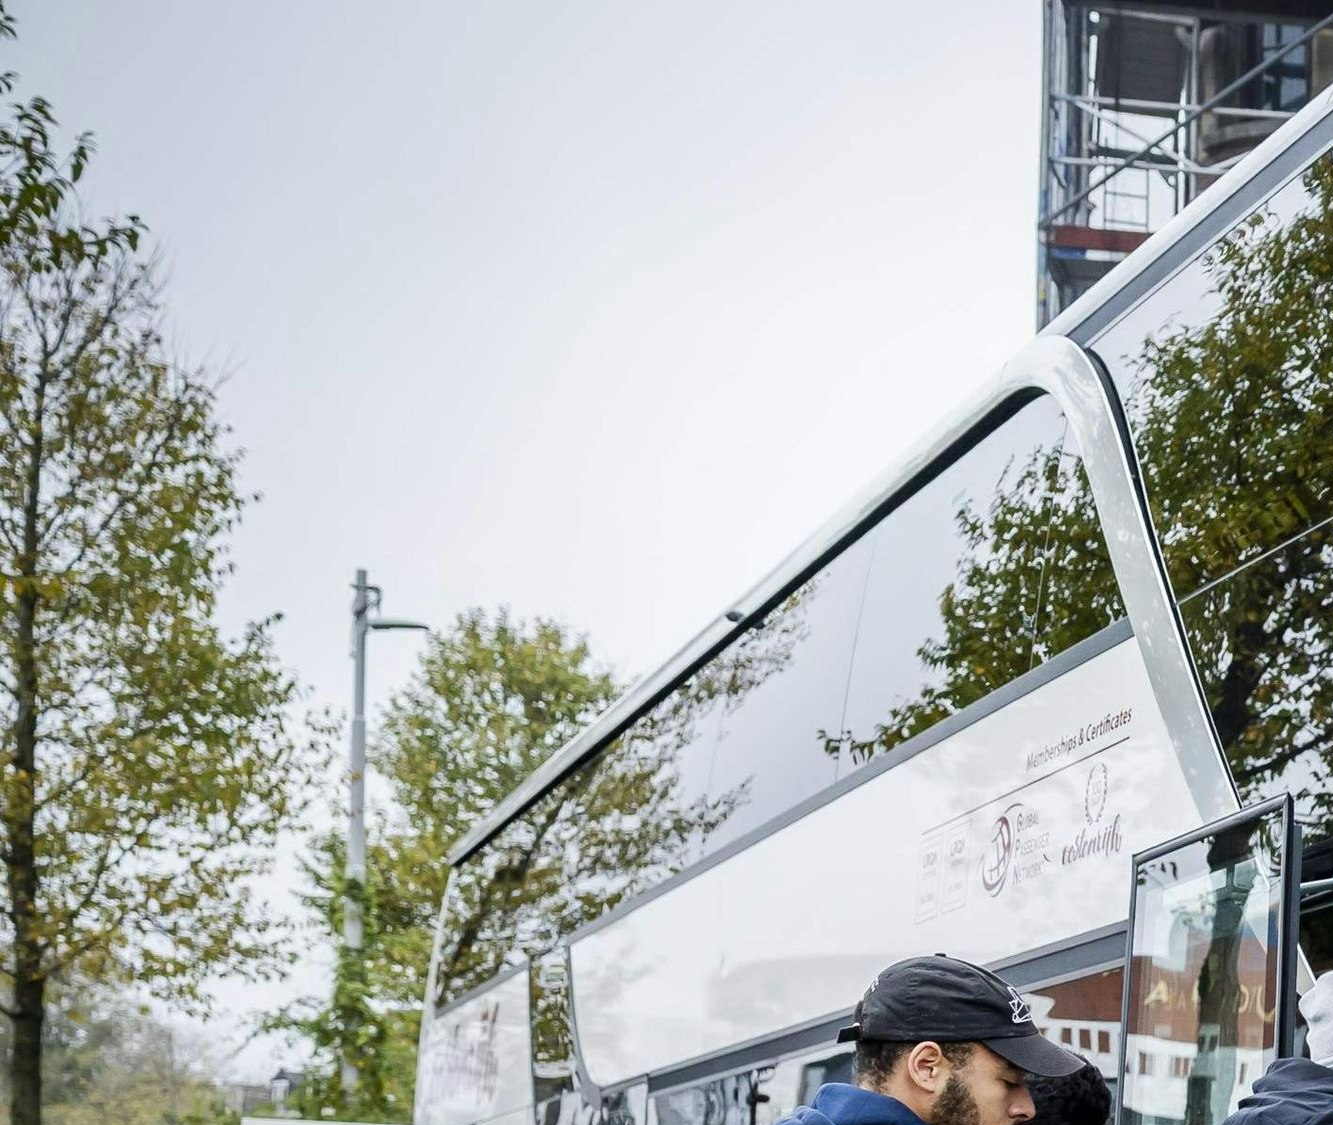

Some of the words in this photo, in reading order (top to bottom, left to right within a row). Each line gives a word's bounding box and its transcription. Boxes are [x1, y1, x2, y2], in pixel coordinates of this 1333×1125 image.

[1027, 735, 1077, 768] Memberships
[1079, 728, 1085, 746] &
[1086, 708, 1132, 742] Certificates
